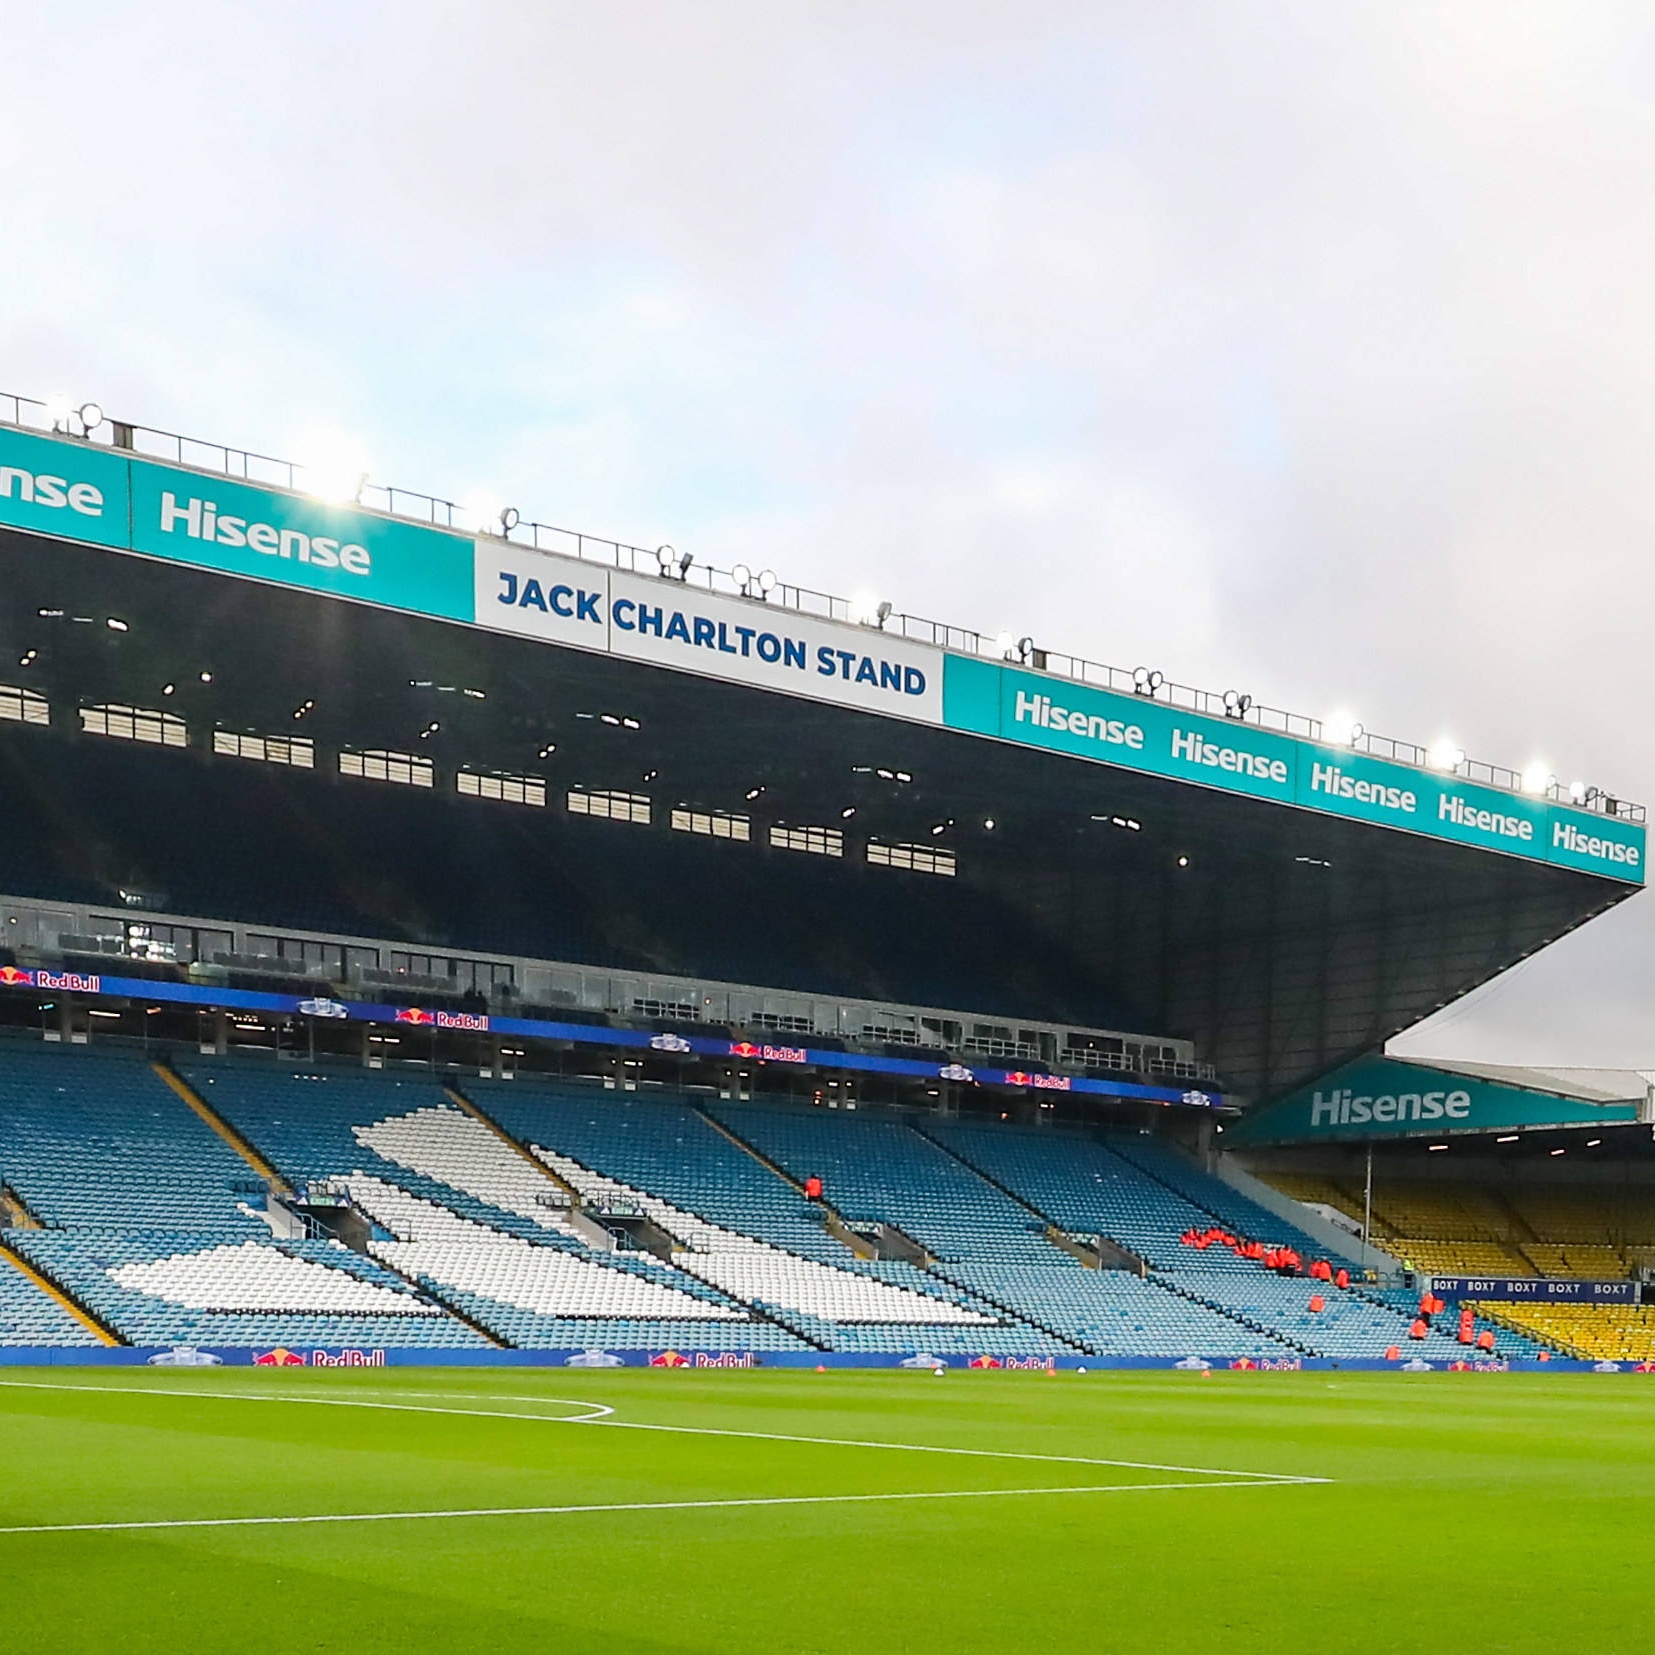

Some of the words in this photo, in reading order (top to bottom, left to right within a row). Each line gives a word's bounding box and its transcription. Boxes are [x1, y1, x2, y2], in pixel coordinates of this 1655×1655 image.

[160, 492, 371, 577] Hisense
[497, 572, 602, 624] JACK
[612, 598, 807, 670] CHARLTON
[817, 645, 926, 697] STAND
[1014, 690, 1145, 751] Hisense
[1170, 728, 1288, 783] Hisense
[1310, 762, 1417, 814] Hisense
[1438, 792, 1534, 842] Hisense
[1552, 821, 1640, 867] Hisense
[1310, 1089, 1472, 1127] Hisense
[1433, 1280, 1458, 1290] BOXT
[1467, 1281, 1495, 1291] BOXT
[1507, 1282, 1538, 1293] BOXT
[1548, 1283, 1581, 1293] BOXT
[1594, 1284, 1628, 1294] BOXT
